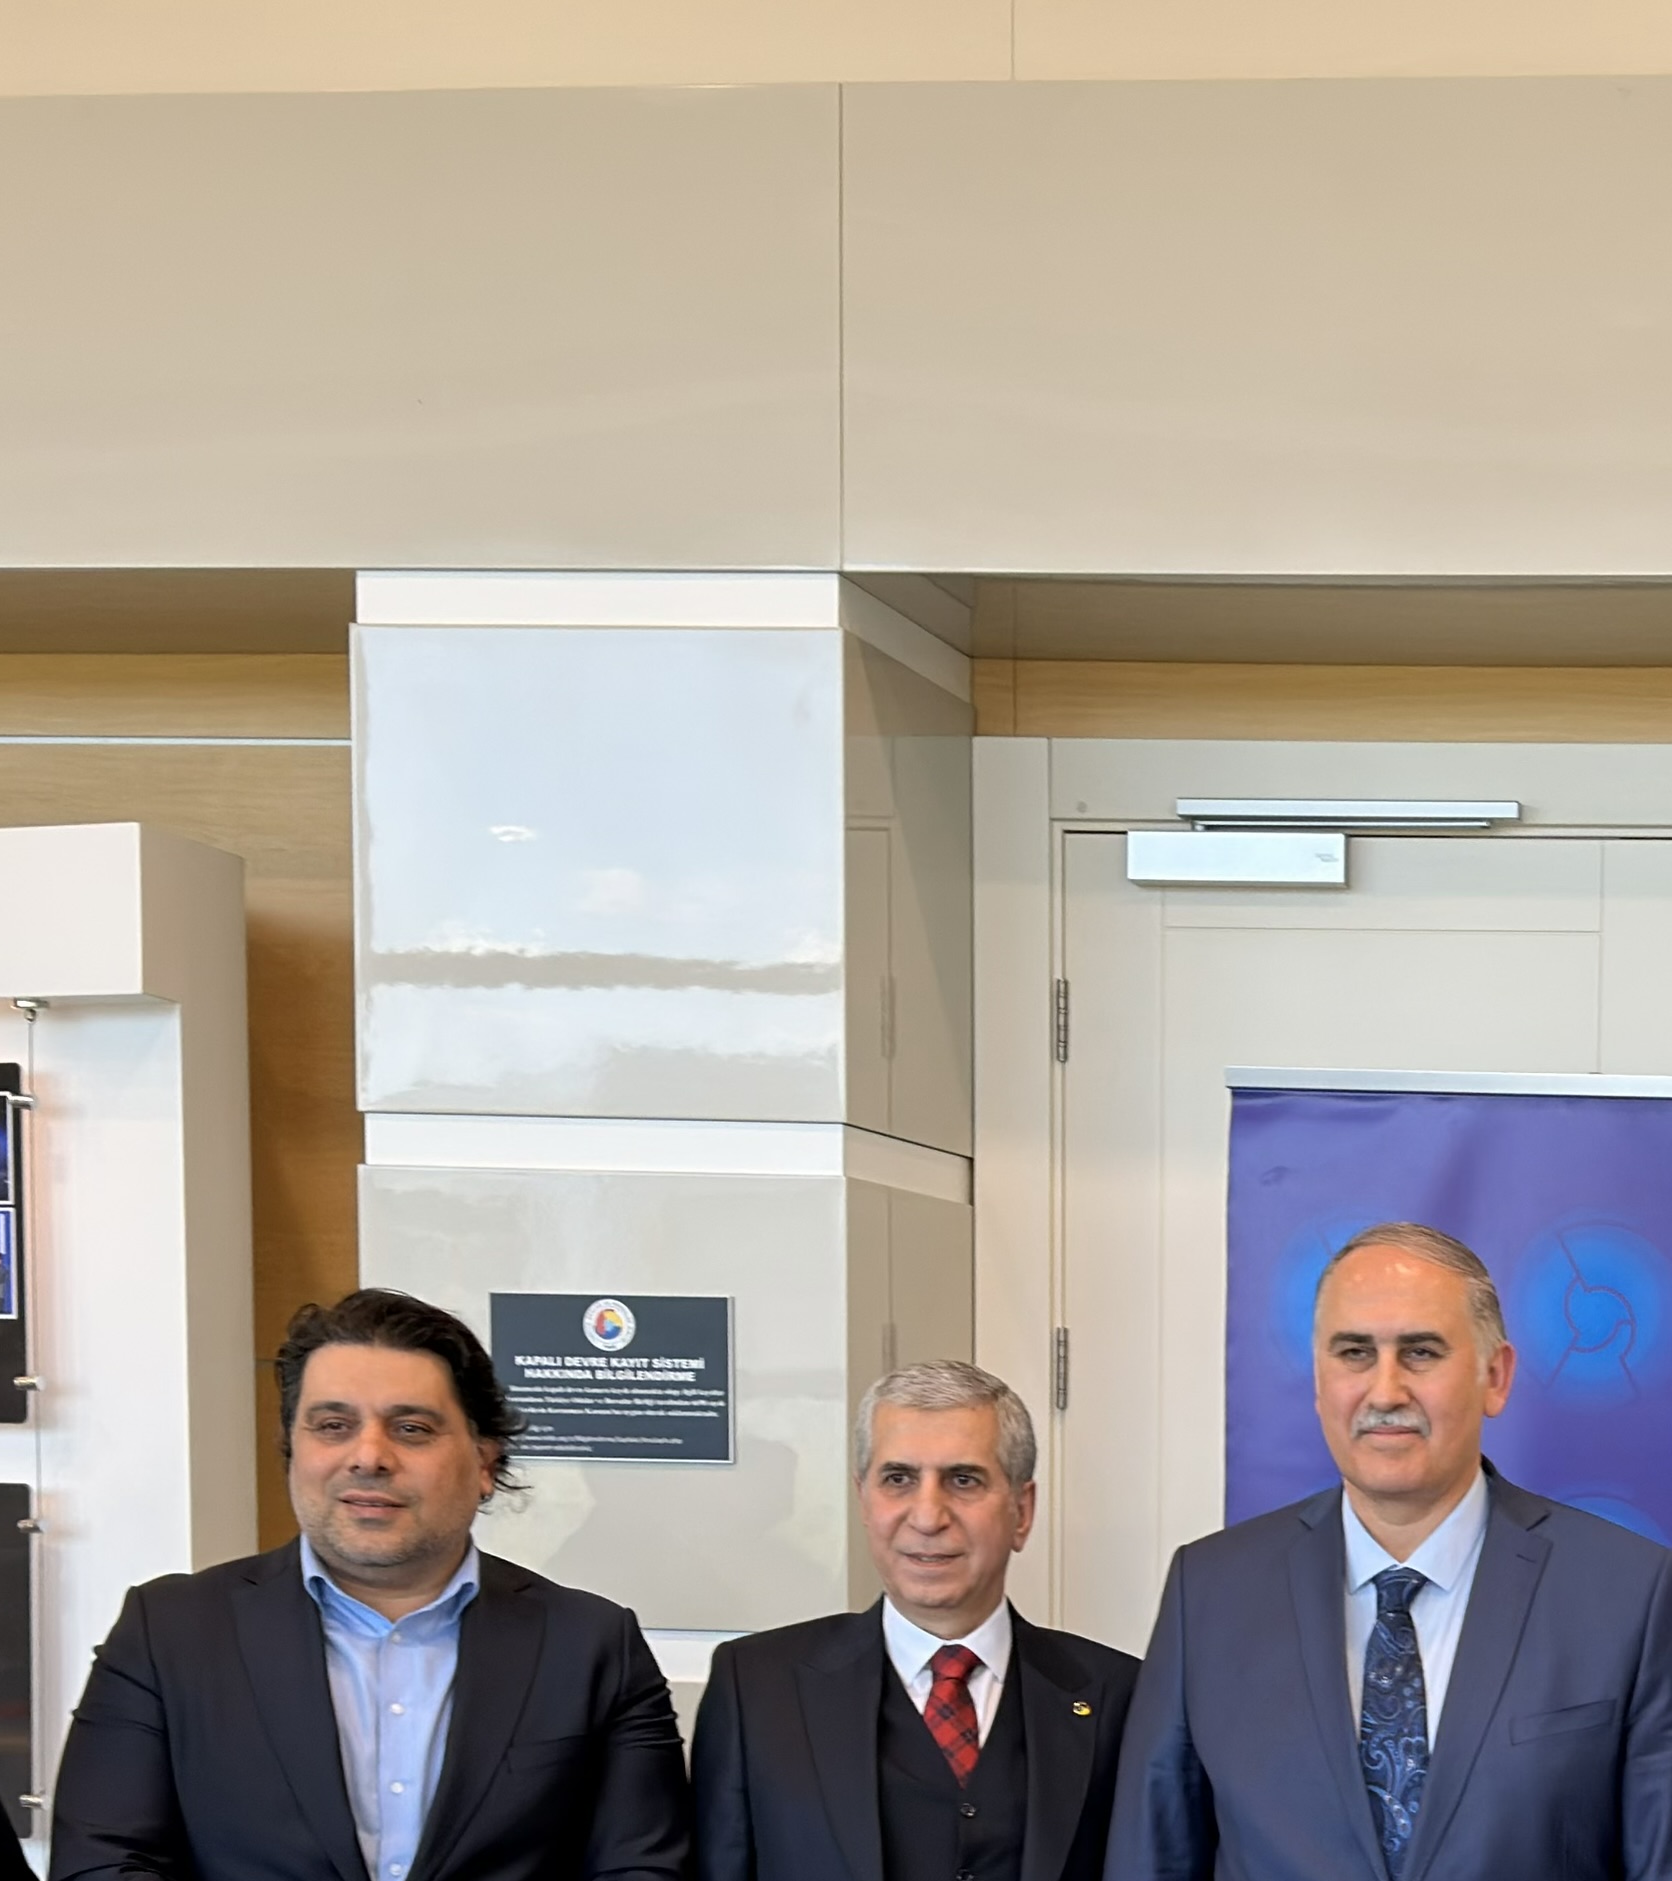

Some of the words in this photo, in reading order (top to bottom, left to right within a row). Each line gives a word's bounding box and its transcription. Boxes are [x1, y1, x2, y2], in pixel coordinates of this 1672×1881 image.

[514, 1355, 563, 1367] KAPALI
[564, 1356, 608, 1368] DEVRE
[609, 1357, 650, 1369] KAYIT
[524, 1368, 594, 1380] HAKKINDA
